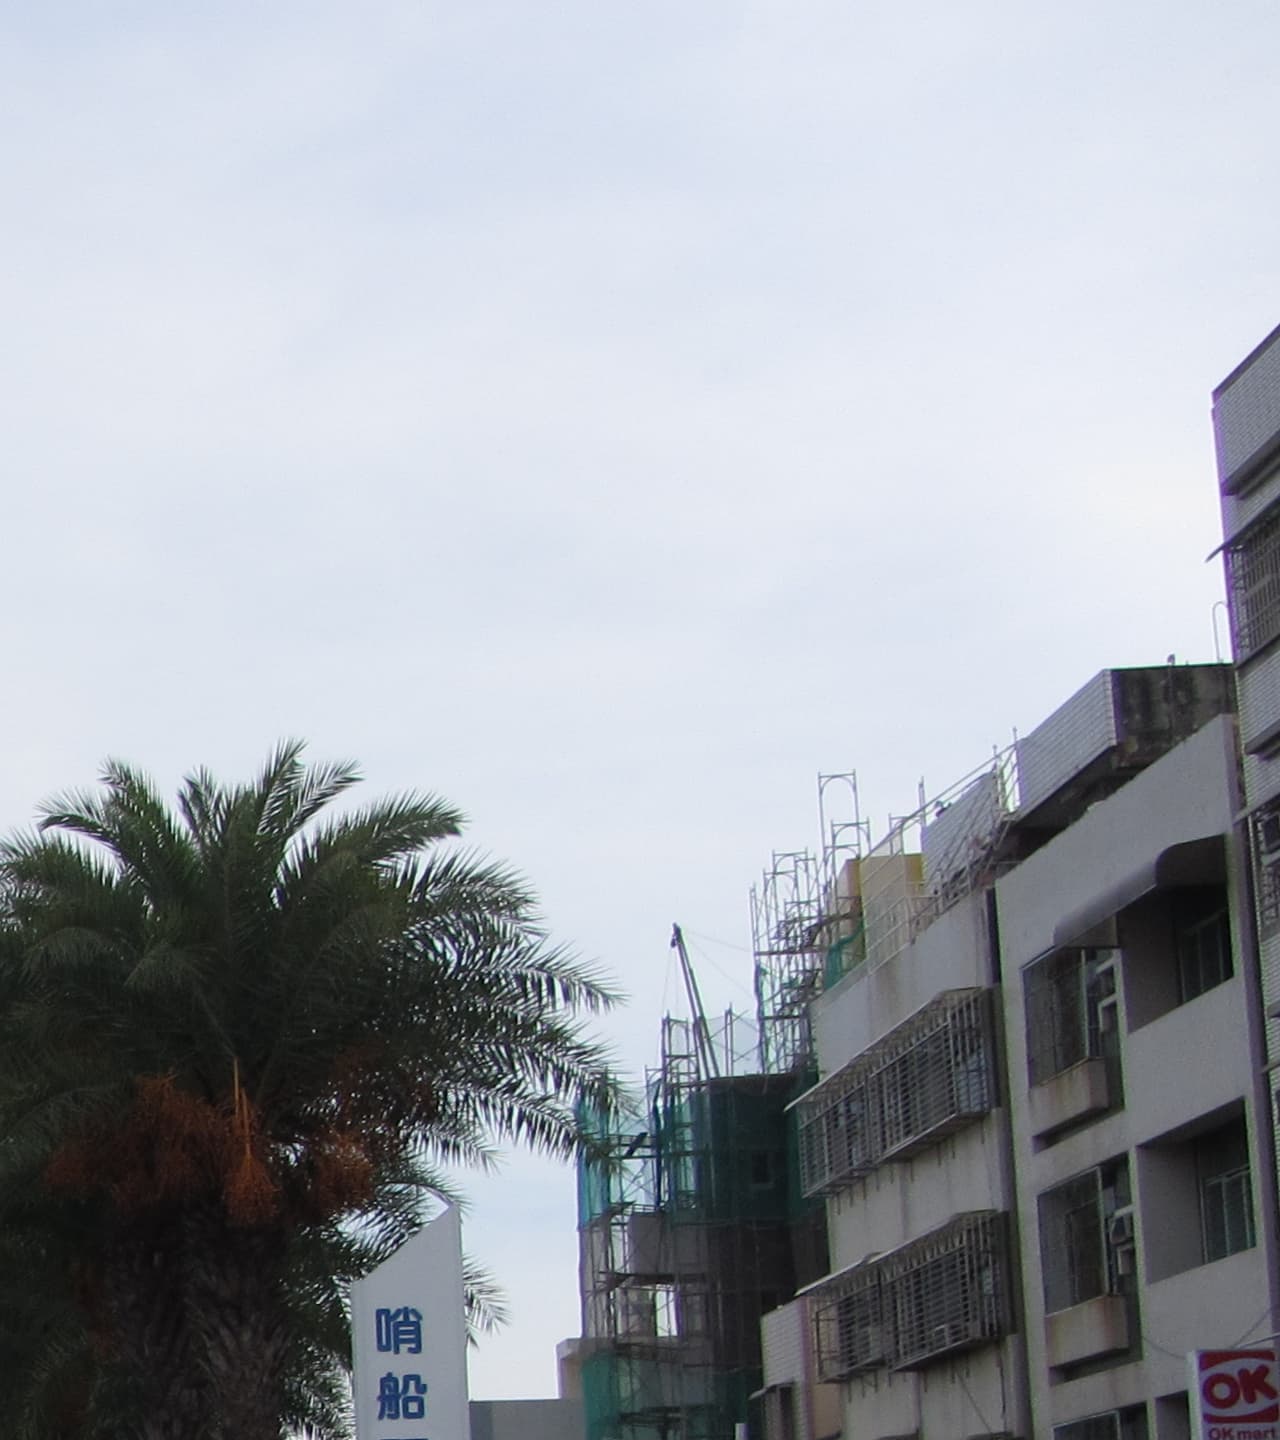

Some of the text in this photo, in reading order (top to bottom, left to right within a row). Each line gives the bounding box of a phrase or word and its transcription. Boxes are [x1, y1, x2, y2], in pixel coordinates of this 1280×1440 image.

[1202, 1364, 1278, 1409] OK
[1208, 1427, 1276, 1440] OK mart
